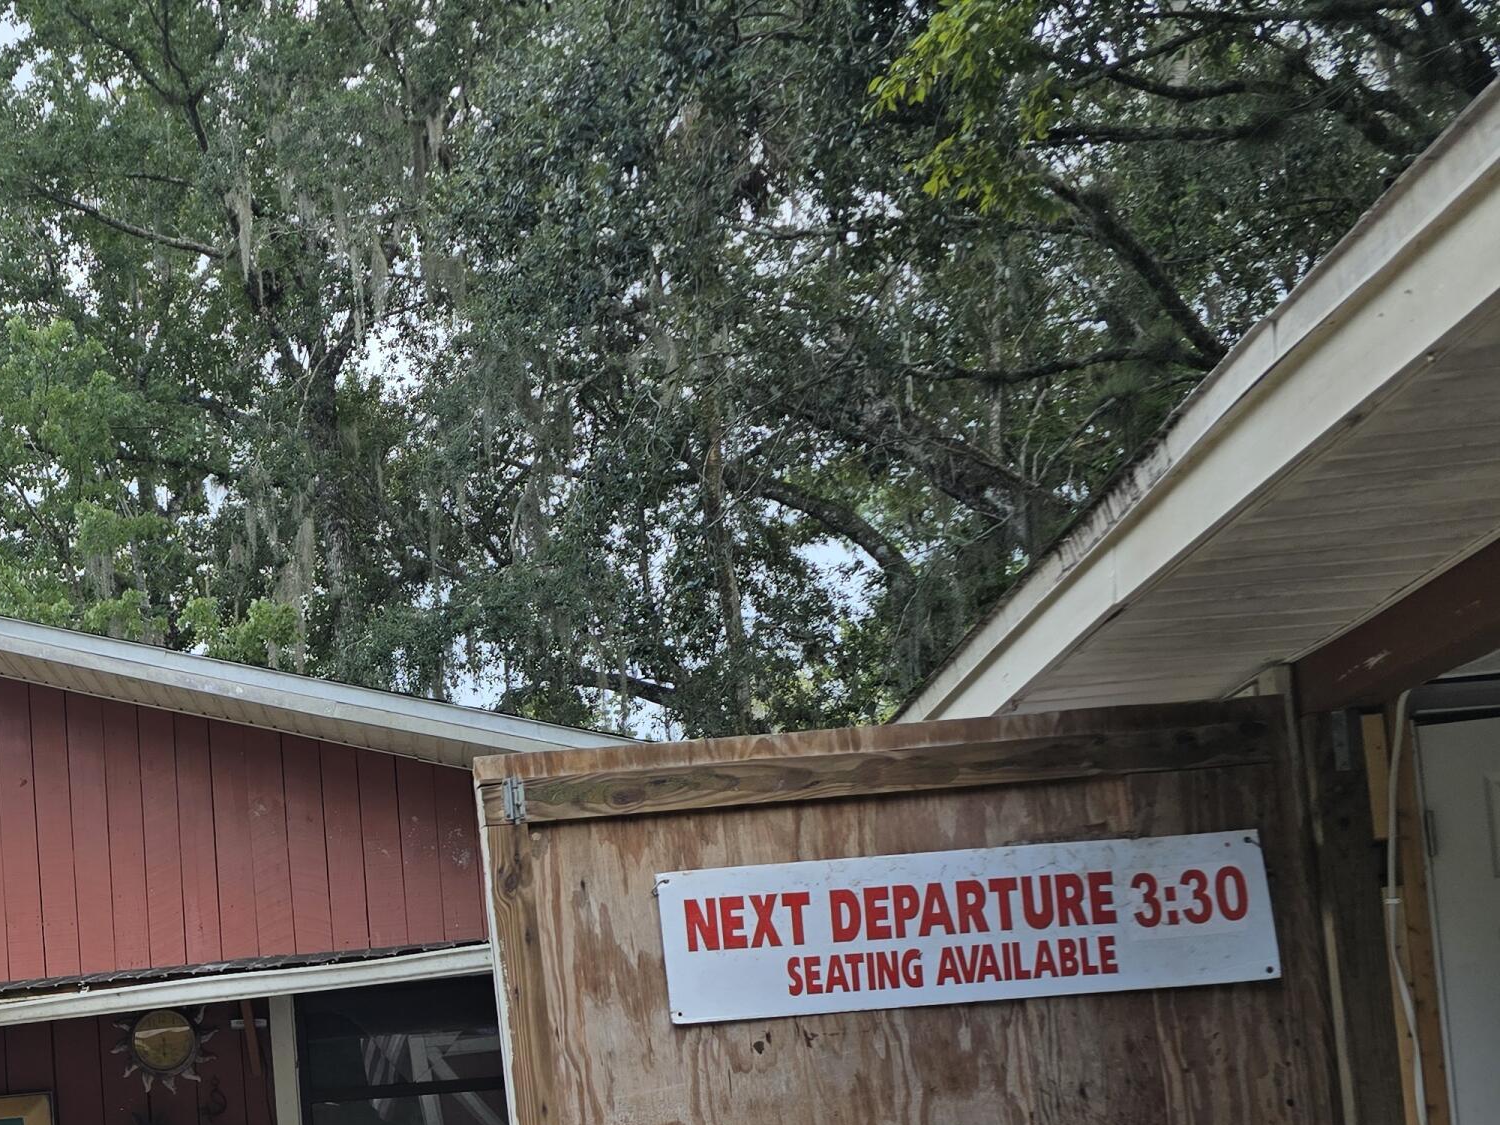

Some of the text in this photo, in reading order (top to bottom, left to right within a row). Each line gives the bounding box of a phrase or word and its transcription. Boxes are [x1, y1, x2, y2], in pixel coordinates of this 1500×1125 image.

[684, 865, 1249, 952] NEXT DEPARTURE 3:30
[786, 935, 1119, 996] SEATING AVAILABLE
